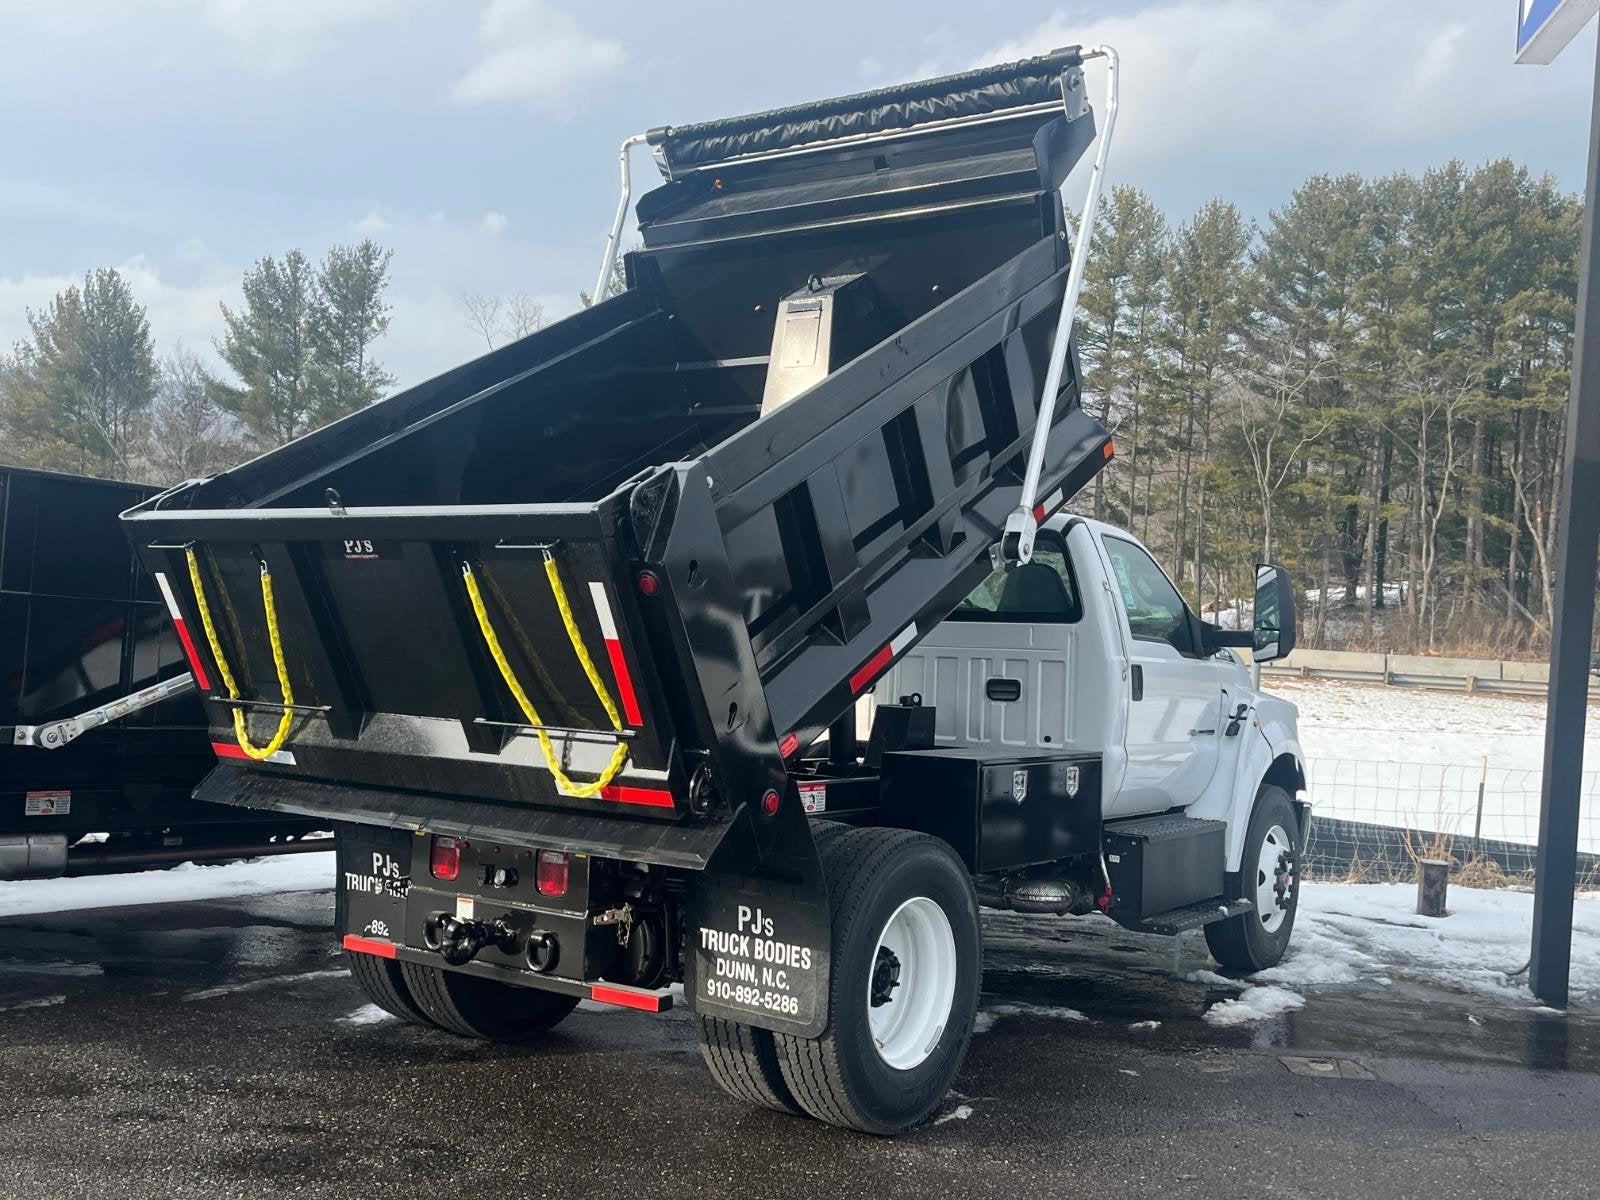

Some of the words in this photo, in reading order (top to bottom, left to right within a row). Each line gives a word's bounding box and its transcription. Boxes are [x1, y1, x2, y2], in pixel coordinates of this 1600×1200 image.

[738, 905, 774, 937] PJ's
[700, 927, 750, 958] TRUCK
[754, 938, 812, 970] BODIES
[716, 957, 758, 987] DUNN,
[762, 967, 790, 991] N.C.
[707, 978, 799, 1015] 910-892-5286
